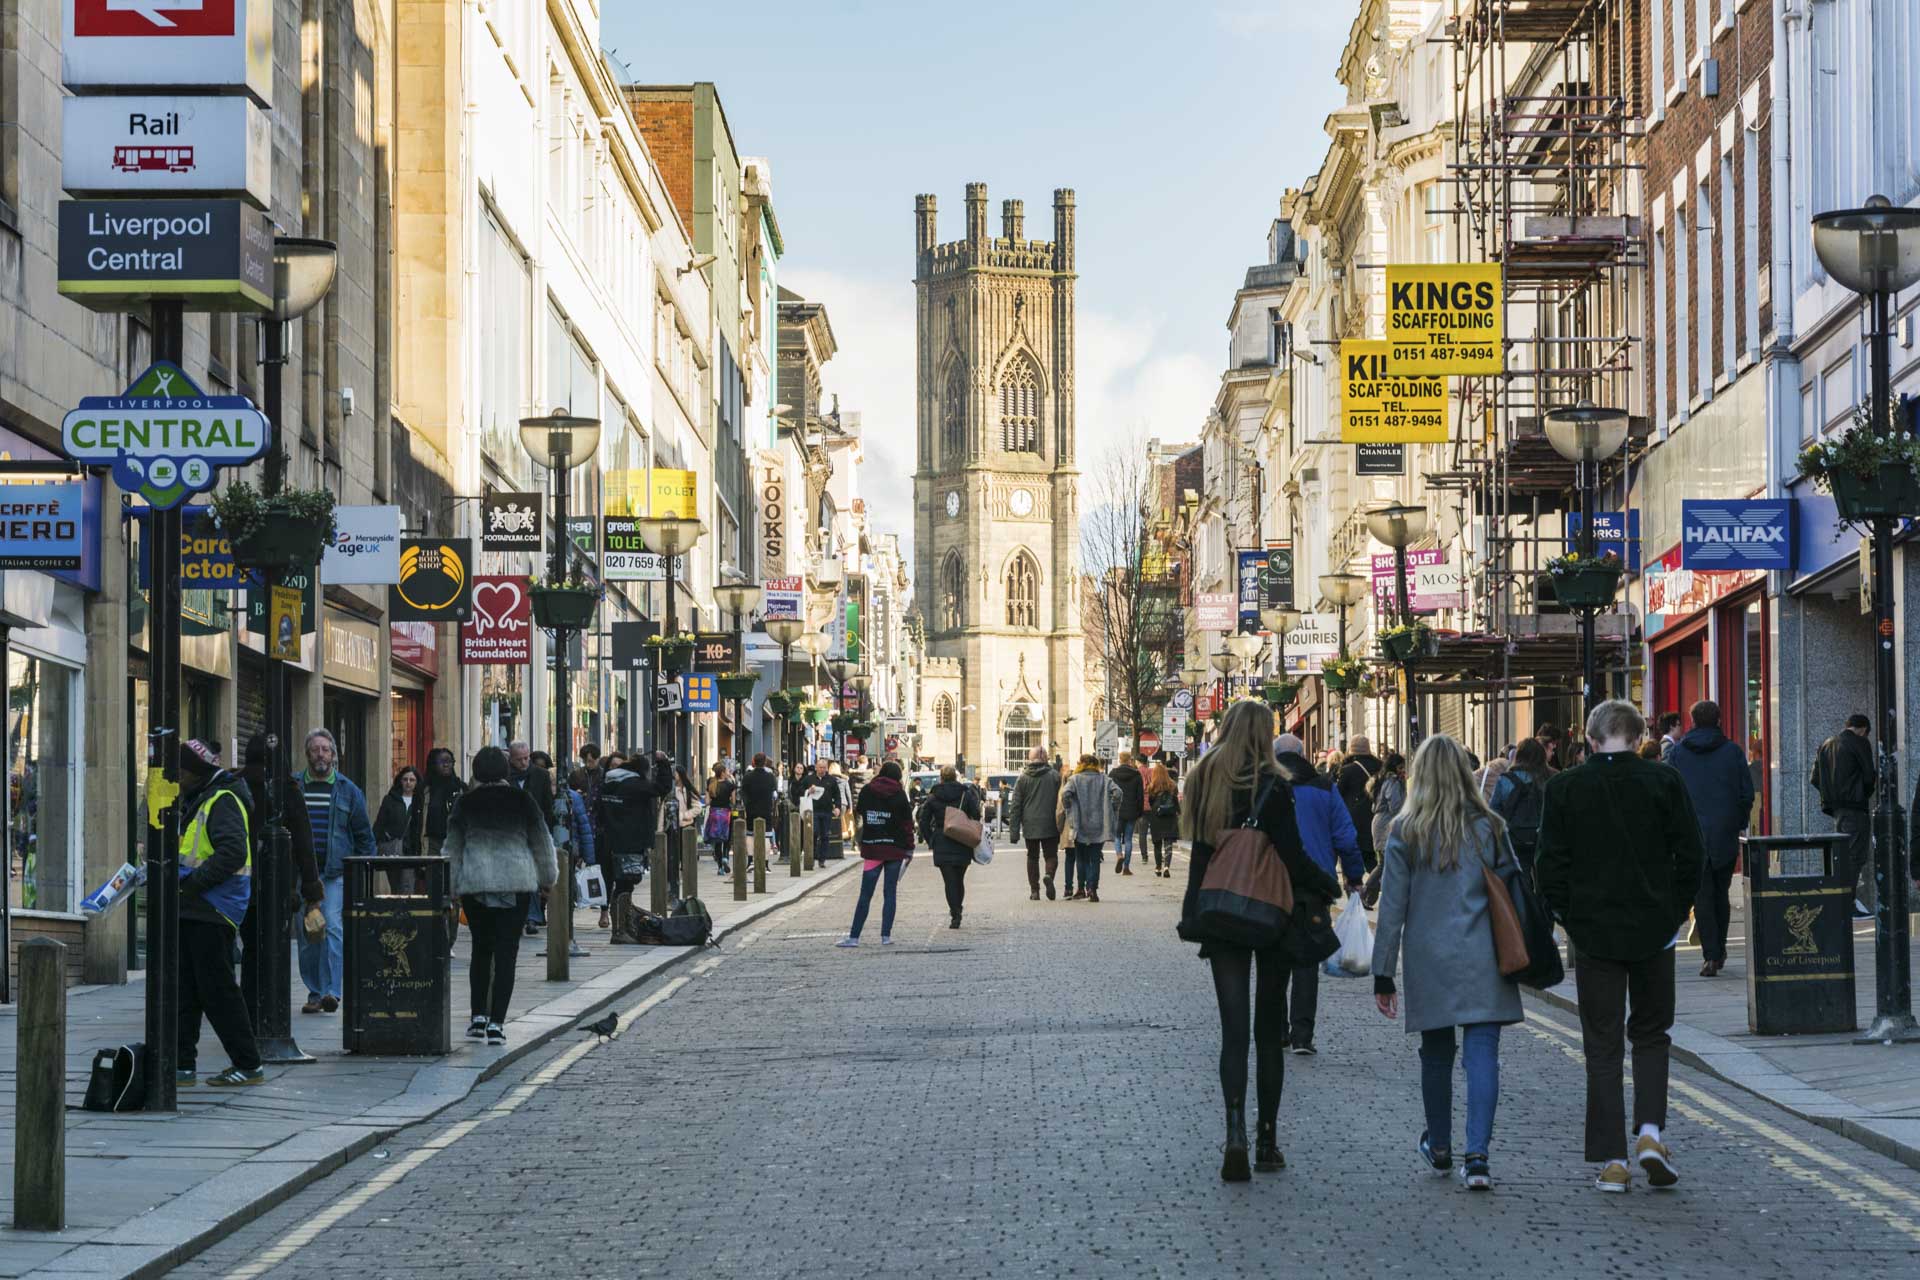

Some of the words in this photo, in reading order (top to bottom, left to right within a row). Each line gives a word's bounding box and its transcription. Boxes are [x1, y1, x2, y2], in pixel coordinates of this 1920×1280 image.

[129, 113, 179, 135] Rail
[88, 212, 210, 240] Liverpool
[87, 247, 183, 270] Central
[1392, 281, 1494, 310] KINGS
[1392, 312, 1494, 329] SCAFFOLDING
[1428, 332, 1458, 345] TEL.
[1393, 348, 1425, 360] 0151
[1431, 347, 1494, 360] 487-9494
[108, 399, 214, 409] LIVERPOOL
[1381, 401, 1410, 413] TEL.
[1349, 415, 1379, 427] 0151
[1384, 415, 1442, 427] 487-9494
[71, 418, 256, 449] CENTRAL
[657, 486, 672, 495] TO
[675, 487, 695, 496] LET
[1, 499, 60, 516] CAFFÈ
[763, 467, 783, 557] LOOKS
[1592, 517, 1611, 527] HE
[0, 521, 75, 540] ERO
[1686, 525, 1785, 543] HALIFAX
[355, 534, 395, 543] Merseyside
[608, 535, 623, 550] TO
[338, 544, 364, 557] age
[365, 544, 380, 553] UK
[1, 559, 31, 567] ITALIAN
[33, 559, 62, 567] COFFEE
[606, 556, 625, 568] 020
[628, 556, 654, 569] 7659
[1418, 552, 1438, 565] LET
[1199, 595, 1212, 604] TO
[1215, 593, 1234, 603] LET
[1296, 618, 1319, 630] ALL
[465, 638, 497, 647] British
[498, 638, 527, 647] Heart
[1285, 632, 1339, 646] NQUIRIES
[465, 649, 527, 659] Foundation
[1799, 953, 1841, 965] Liverpool
